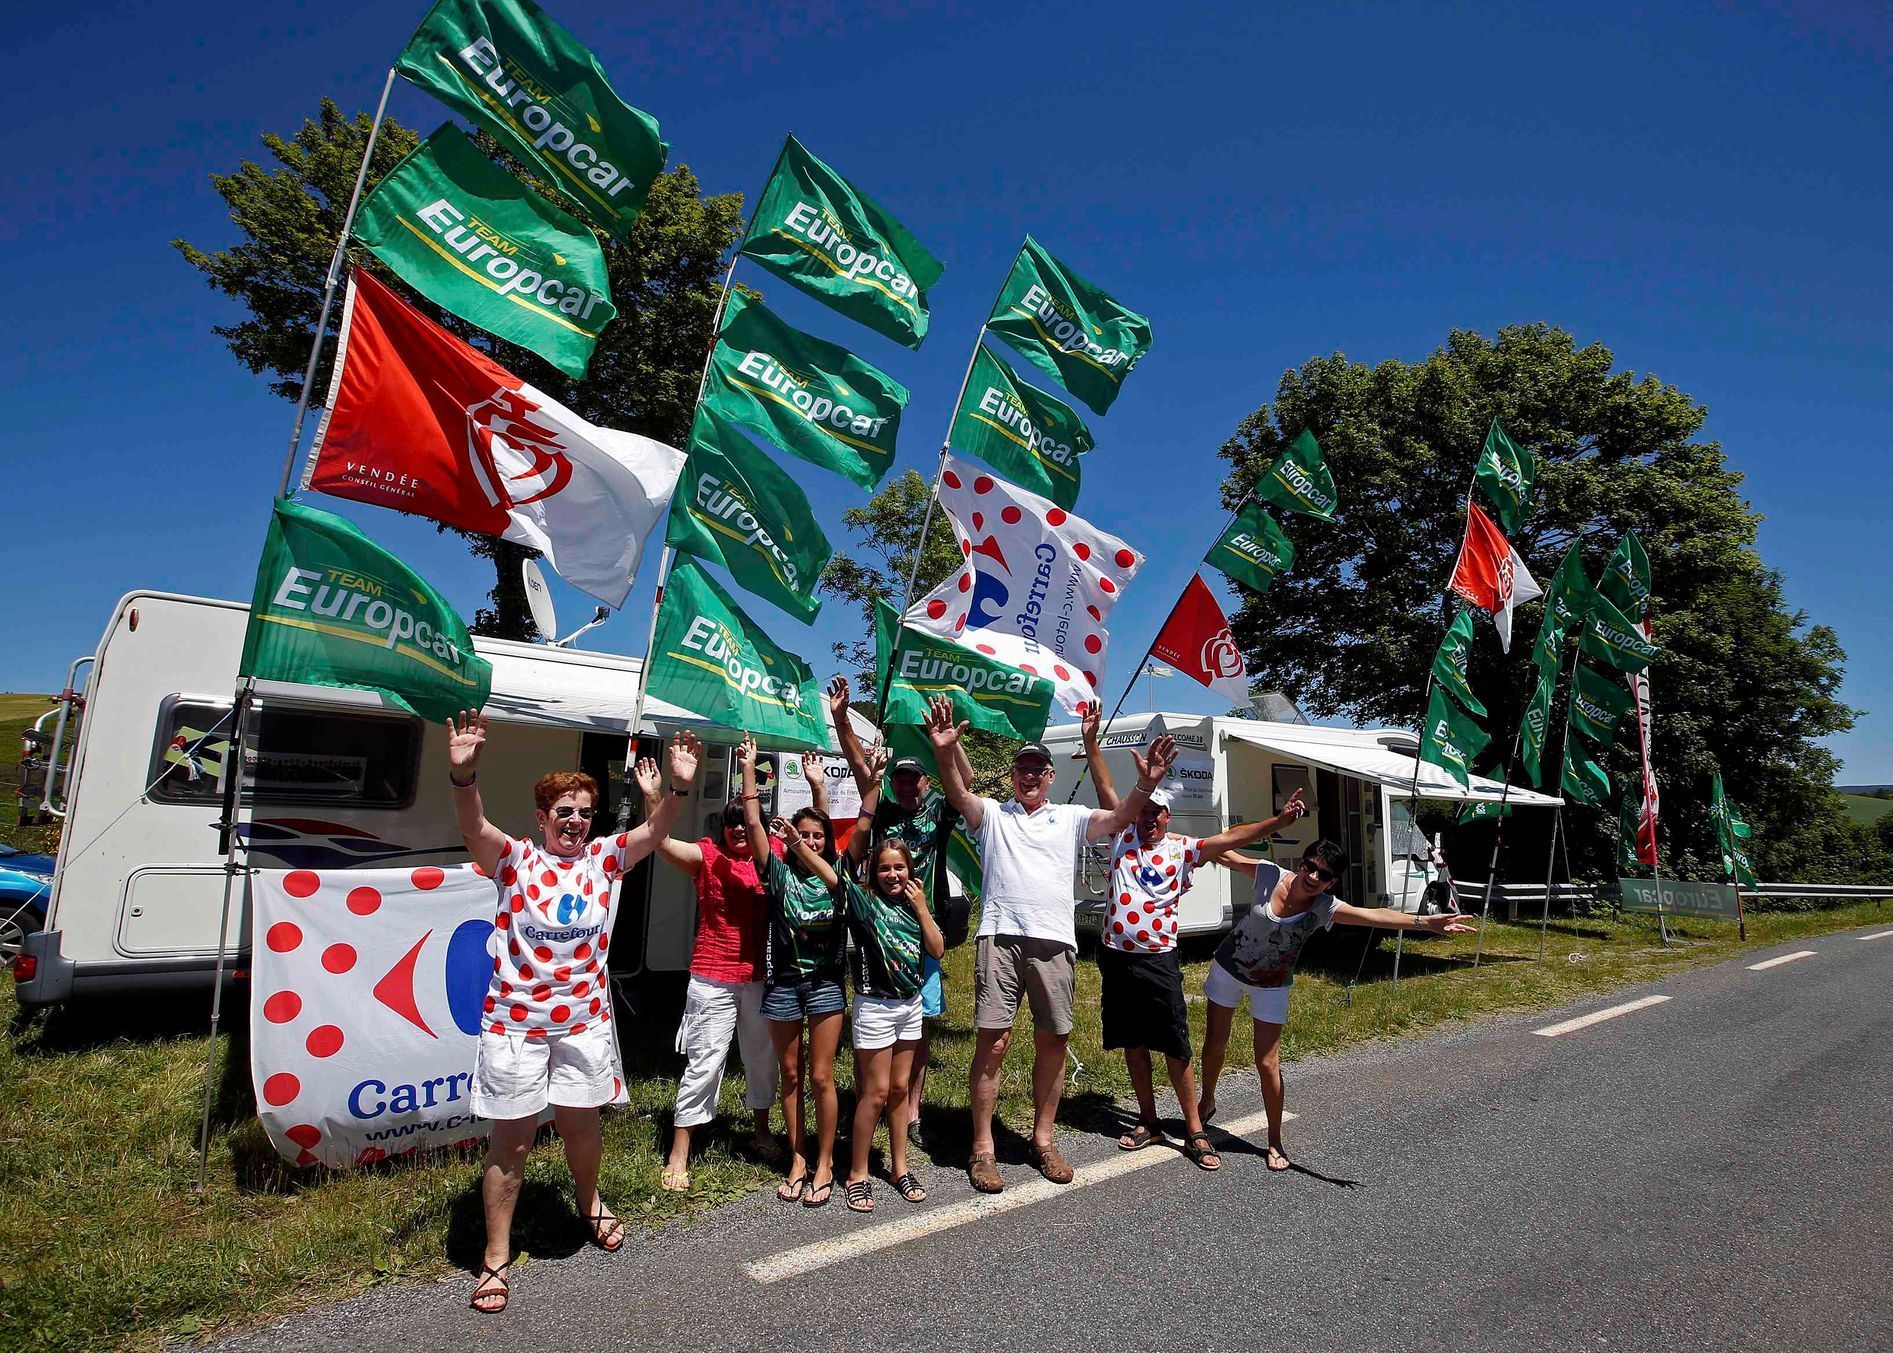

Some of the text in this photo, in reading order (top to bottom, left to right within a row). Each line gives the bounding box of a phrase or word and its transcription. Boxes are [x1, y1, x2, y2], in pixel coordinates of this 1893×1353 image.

[503, 59, 552, 105] TEAM
[458, 36, 635, 198] Europcar
[416, 198, 604, 321] Europcar
[467, 217, 517, 256] TEAM
[784, 201, 919, 299] Europcar
[1020, 284, 1130, 367] Europcar
[737, 350, 889, 439] Europcar
[342, 474, 416, 498] CONSEIL GÉNÉRAL
[346, 462, 419, 489] VENDÉE
[1279, 459, 1333, 509] Europcar
[328, 568, 383, 598] TEAM
[272, 566, 461, 665] Europcar
[1594, 620, 1662, 657] Europcar
[900, 649, 1040, 696] Europcar
[927, 647, 961, 663] TEAM
[1106, 733, 1147, 746] CHAUSSON
[1180, 768, 1214, 781] ŠKODA
[525, 924, 601, 941] Carrefour
[348, 1071, 474, 1120] Carr
